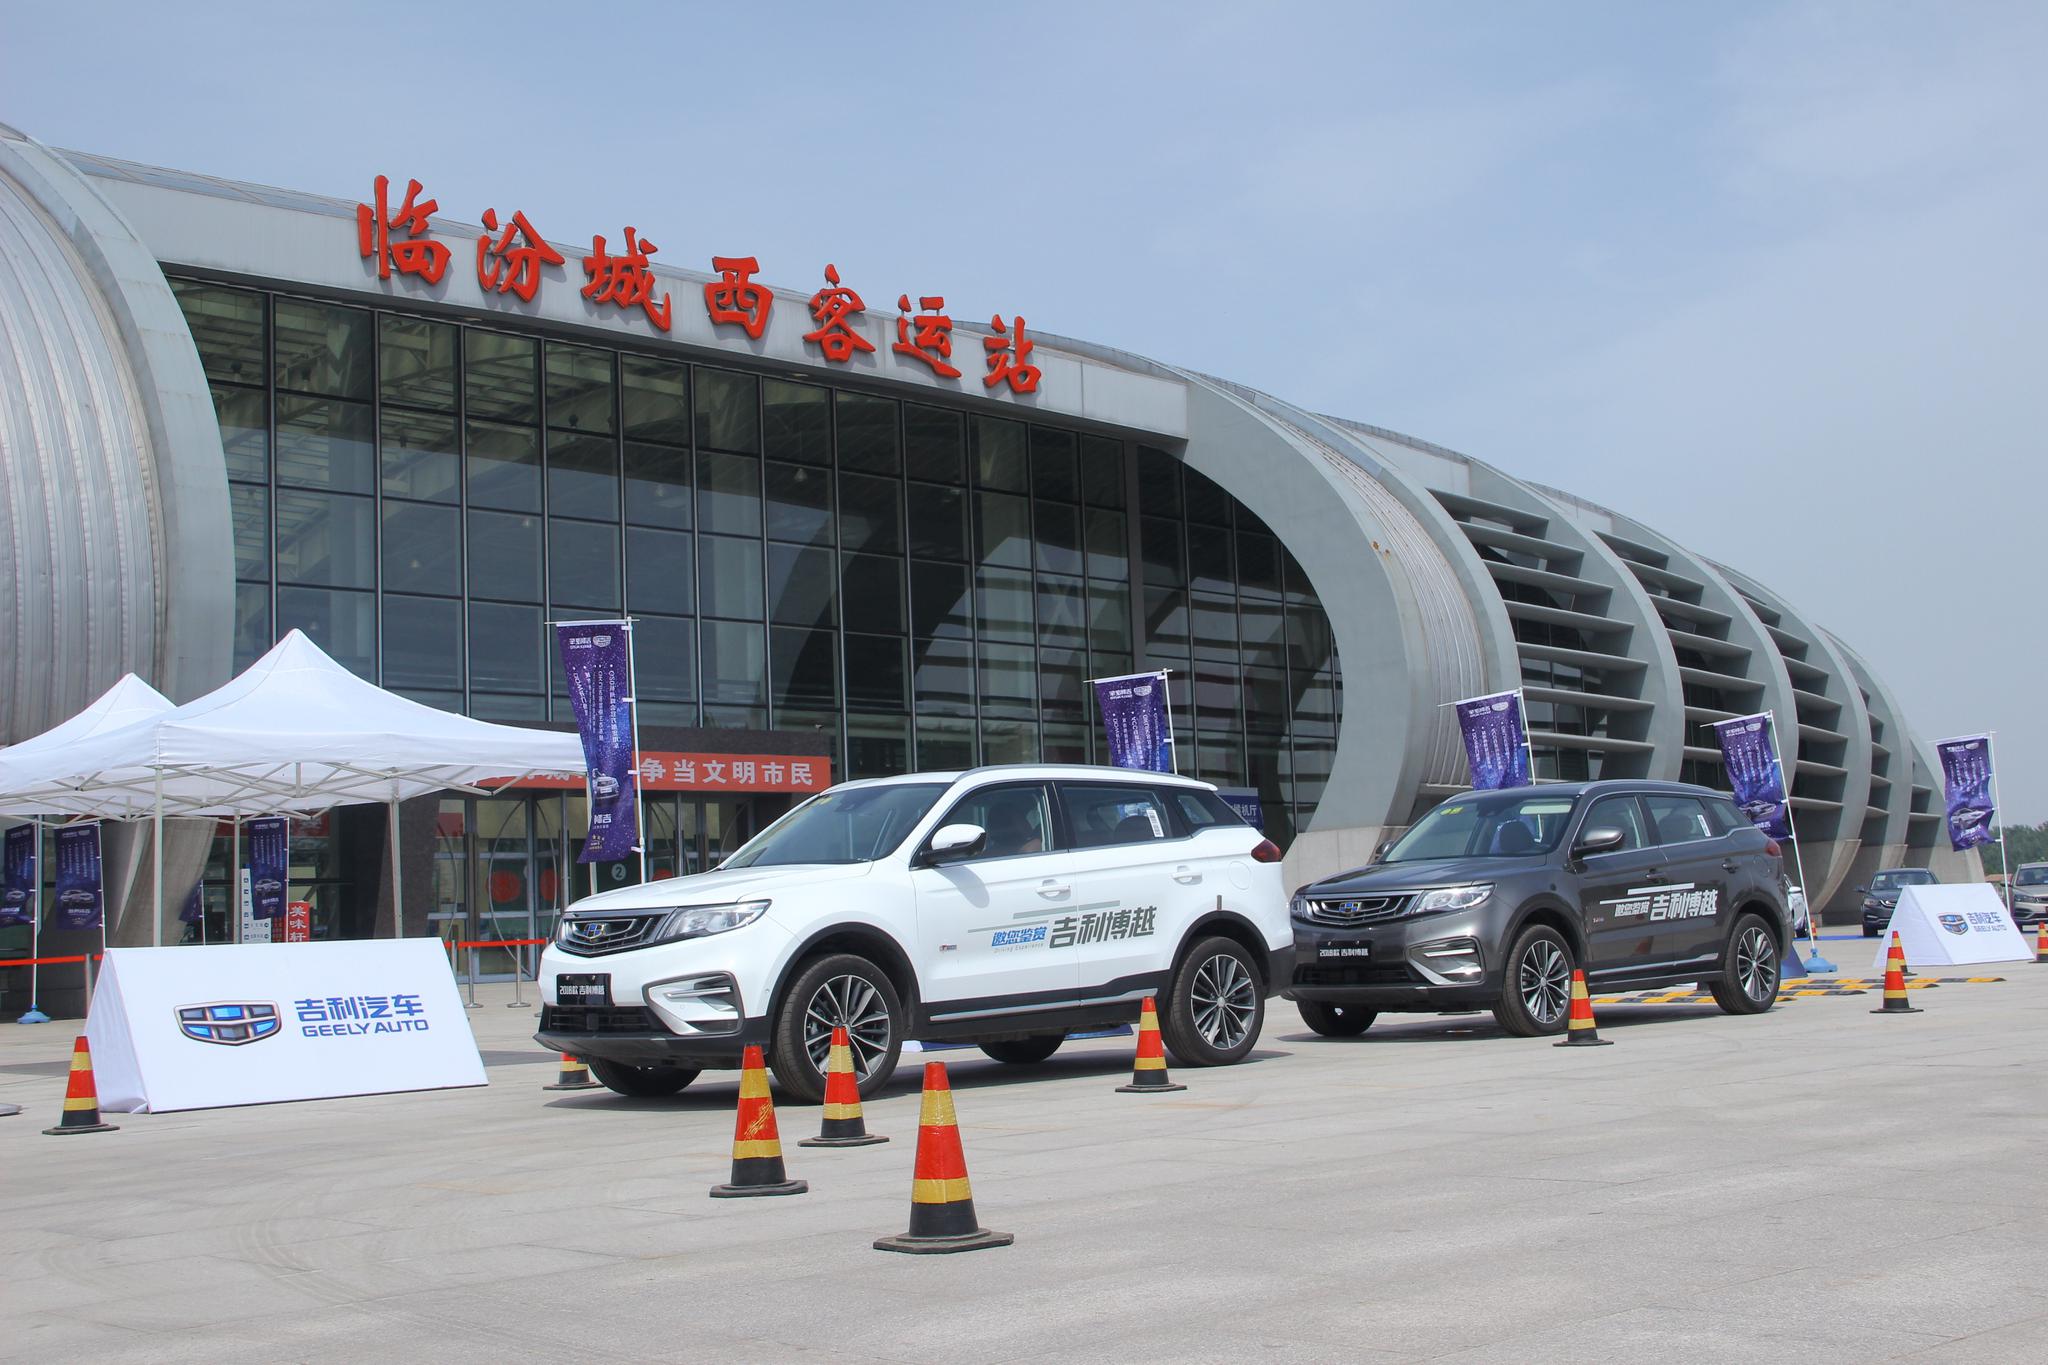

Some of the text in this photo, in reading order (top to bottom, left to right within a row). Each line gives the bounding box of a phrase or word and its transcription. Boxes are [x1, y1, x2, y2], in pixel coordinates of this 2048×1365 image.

[356, 174, 1043, 393] 临汾城西客运站
[640, 758, 814, 785] 争当文明市民
[1650, 889, 1718, 921] 吉利博越
[991, 906, 1157, 949] 邀您鉴赏 吉利博越
[294, 994, 424, 1022] 吉利汽车
[302, 1019, 429, 1037] GEELY AUTO
